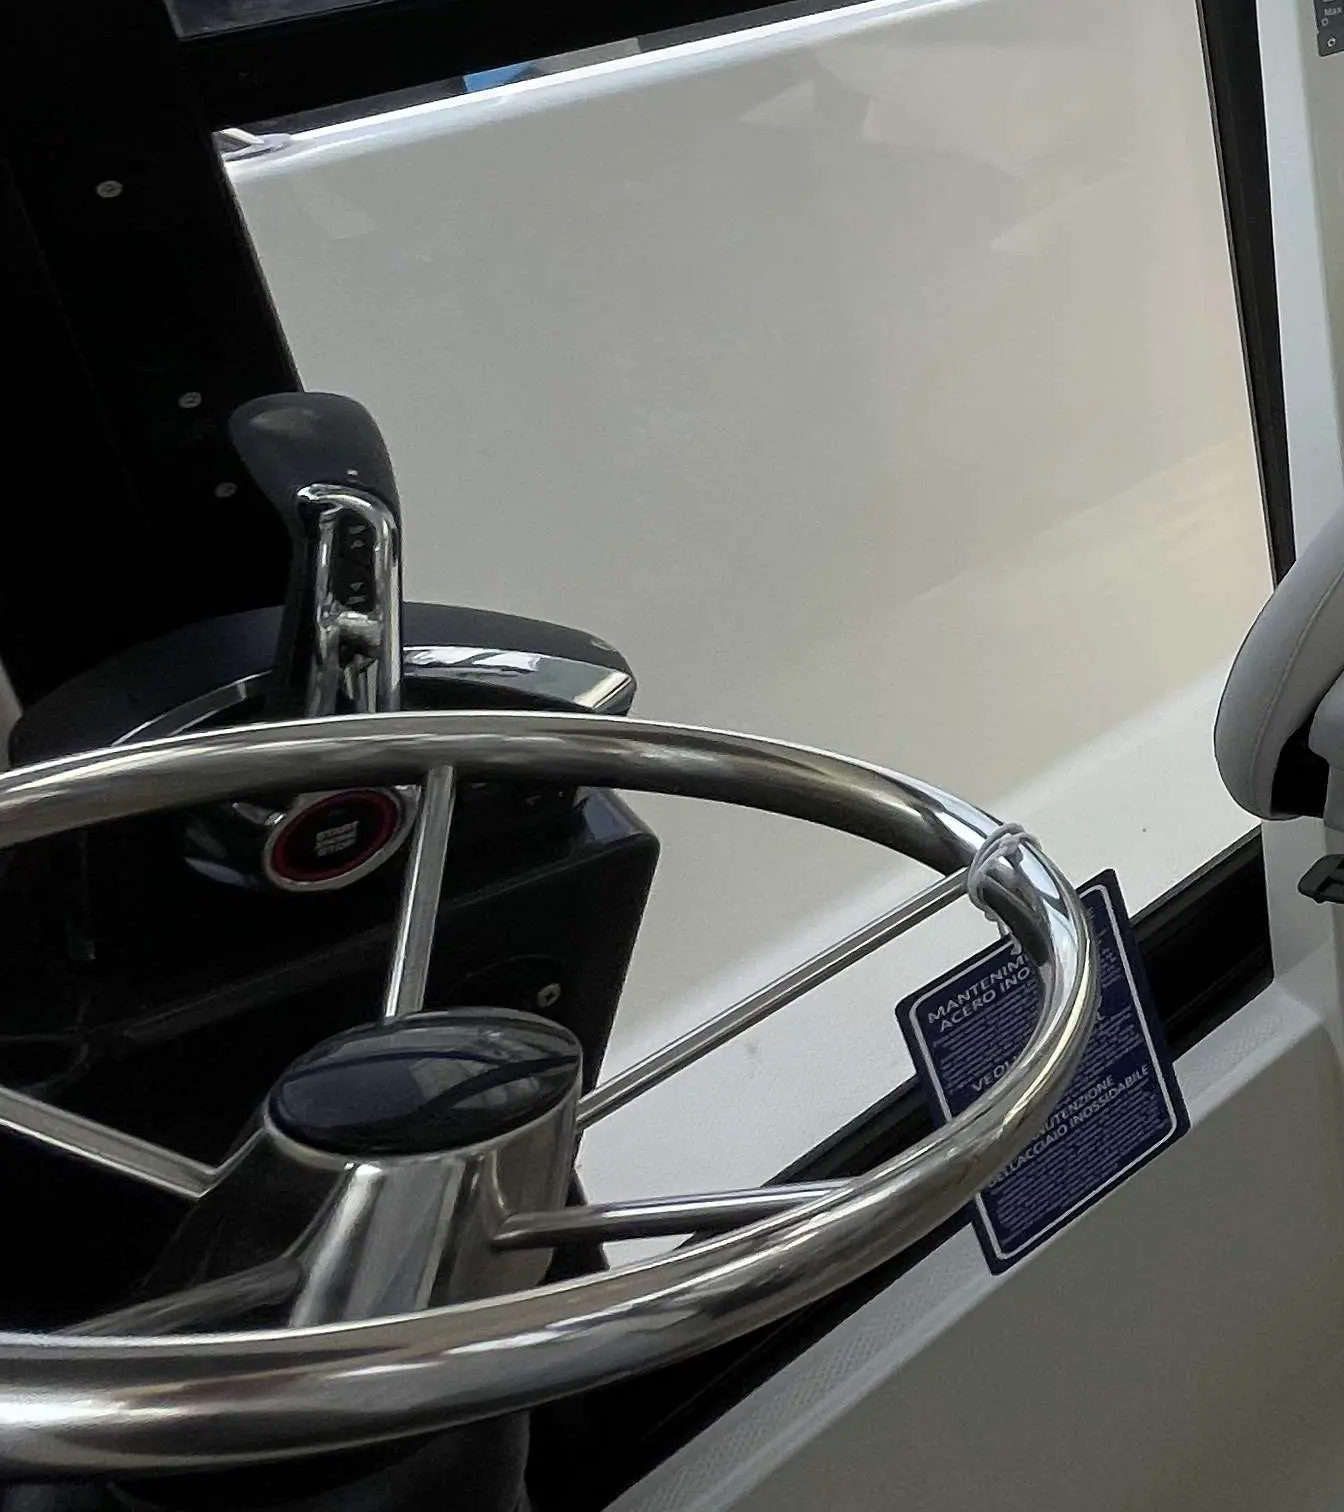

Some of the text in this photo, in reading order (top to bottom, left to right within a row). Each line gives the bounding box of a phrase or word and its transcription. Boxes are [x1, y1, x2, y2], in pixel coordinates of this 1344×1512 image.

[928, 953, 1029, 1024] MANTENIM
[939, 989, 997, 1033] ACERO
[1068, 1063, 1150, 1129] INOSSIDABILE
